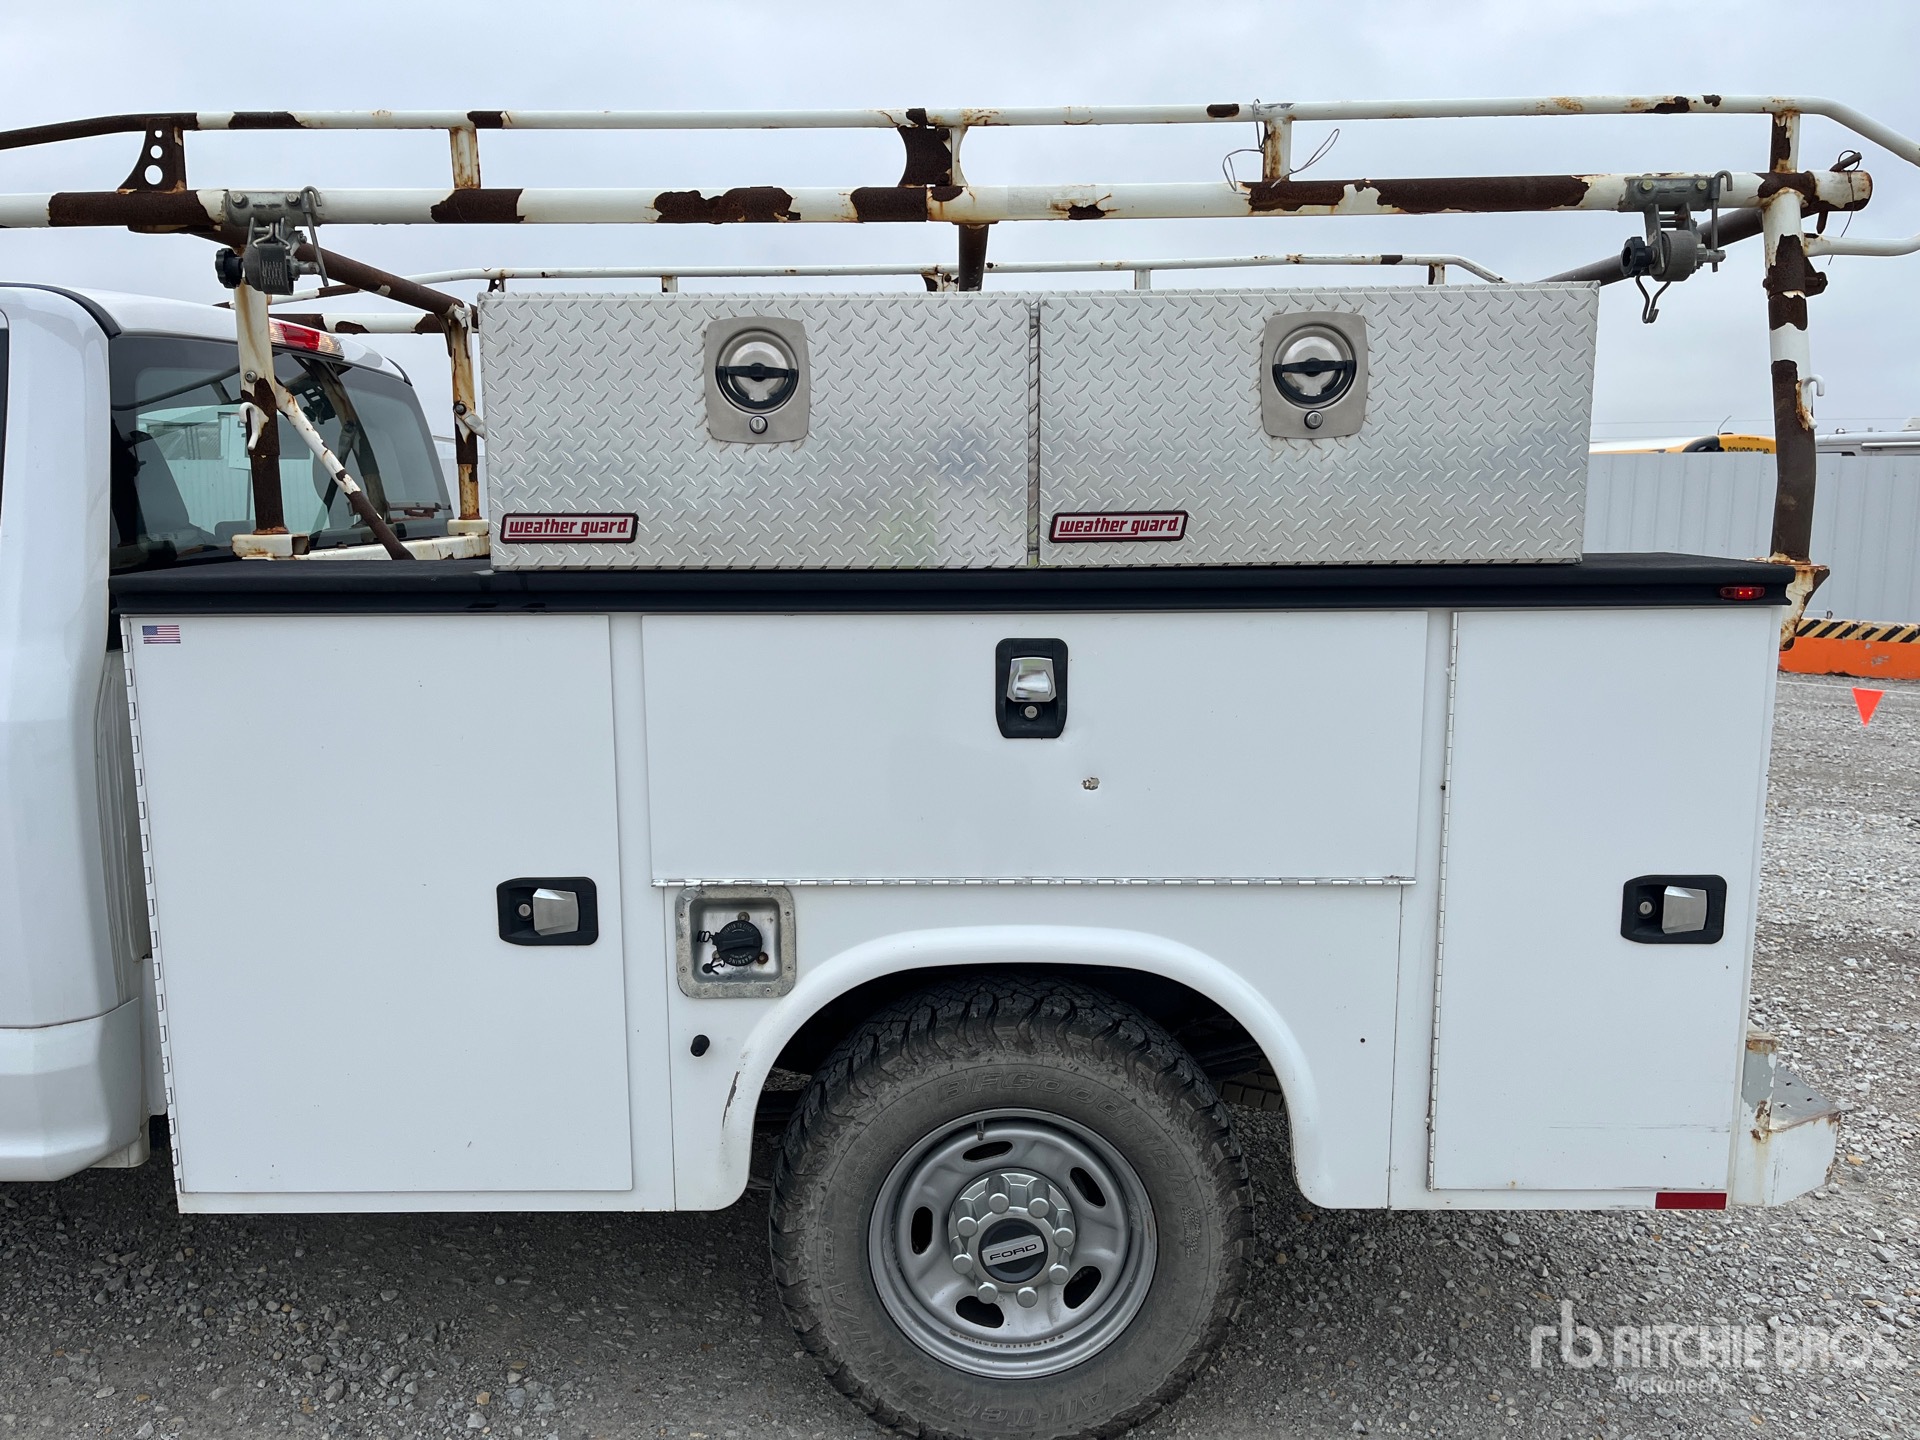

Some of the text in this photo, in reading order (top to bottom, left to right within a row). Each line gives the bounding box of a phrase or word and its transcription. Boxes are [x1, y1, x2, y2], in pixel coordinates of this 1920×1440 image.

[509, 519, 629, 537] weather guard
[1059, 517, 1179, 536] weather guard
[937, 1071, 1192, 1198] BFGoodrich
[989, 1243, 1037, 1261] FORD
